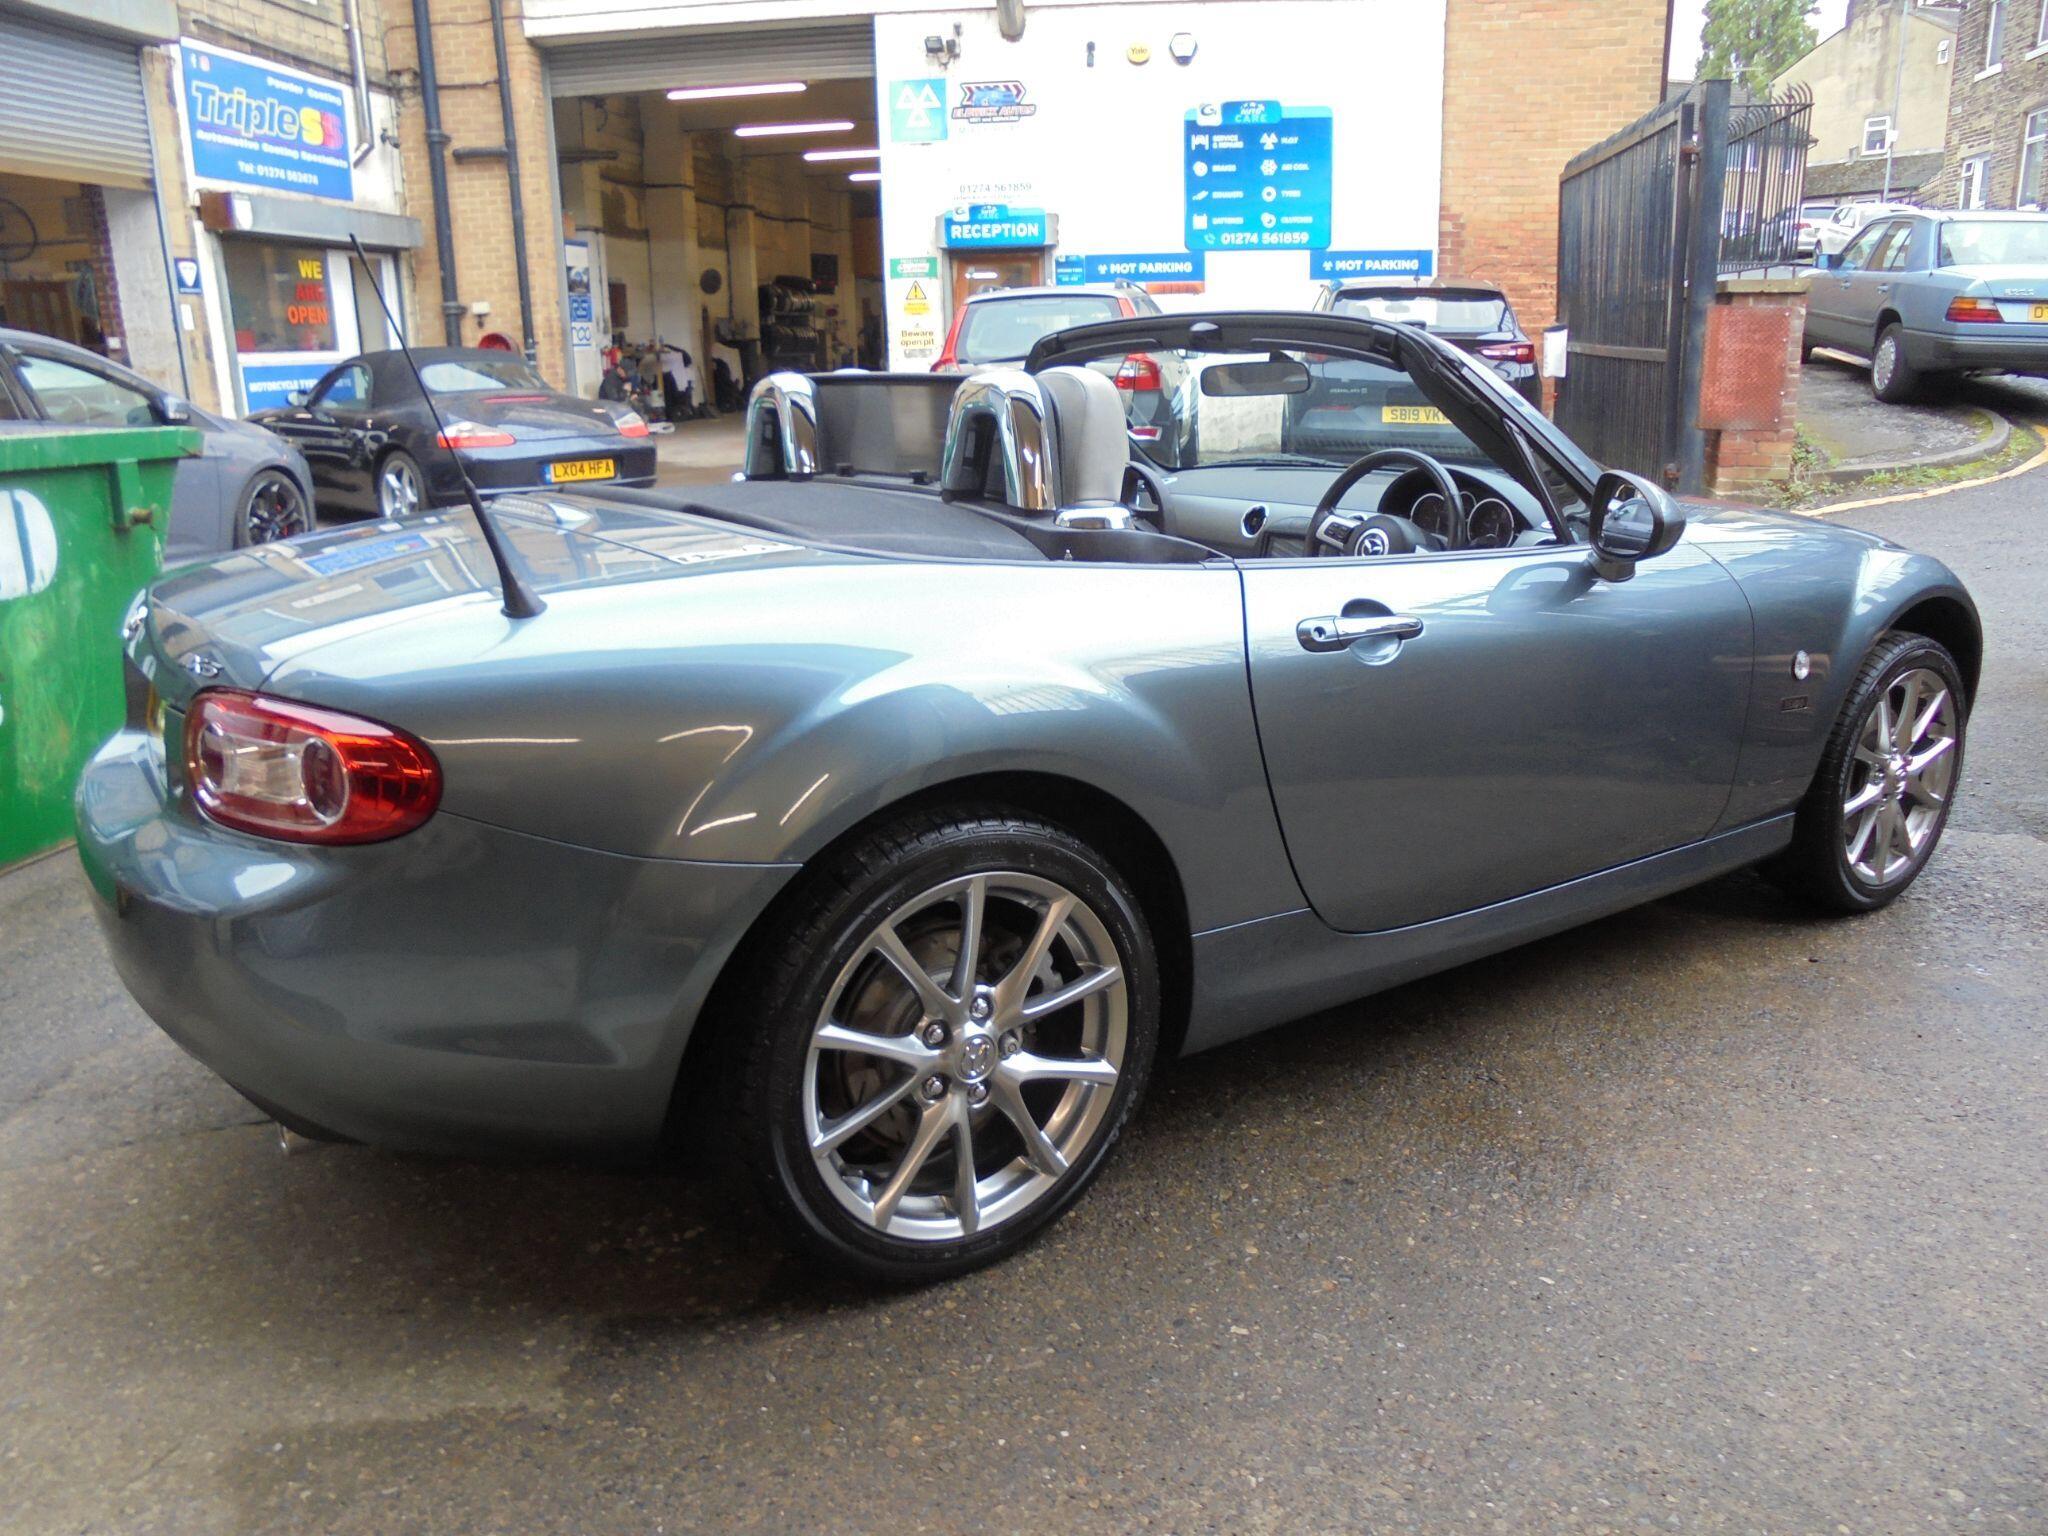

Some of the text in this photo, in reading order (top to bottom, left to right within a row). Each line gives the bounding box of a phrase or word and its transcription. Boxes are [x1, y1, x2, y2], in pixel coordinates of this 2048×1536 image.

[1131, 46, 1148, 55] Yale
[192, 80, 300, 140] Triple
[950, 222, 1039, 239] RECEPTION
[1221, 231, 1310, 245] 01274 561859
[298, 259, 323, 279] WE
[1110, 261, 1193, 274] MOT PARKING
[1335, 259, 1419, 271] MOT PARKING
[287, 305, 328, 325] OPEN
[901, 330, 934, 338] Beware
[1390, 408, 1446, 421] SB19 VK
[553, 460, 612, 478] LX04 HFA
